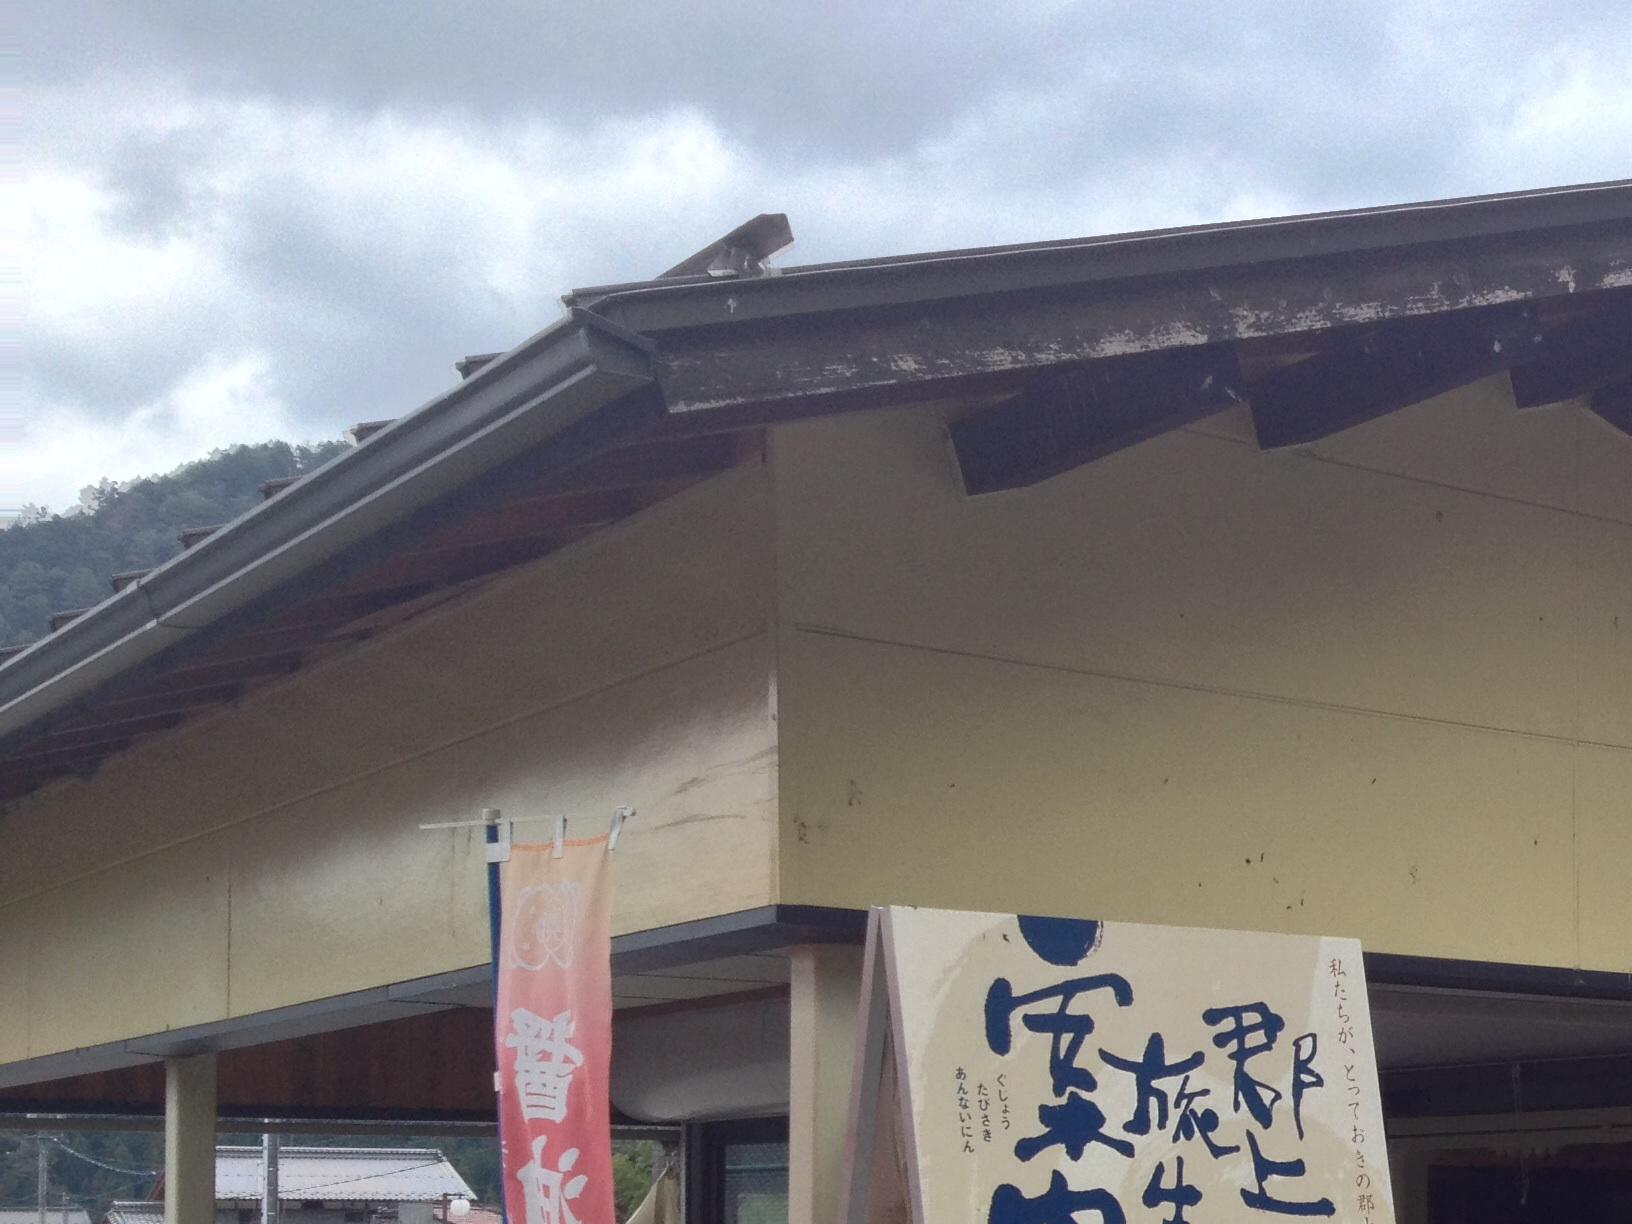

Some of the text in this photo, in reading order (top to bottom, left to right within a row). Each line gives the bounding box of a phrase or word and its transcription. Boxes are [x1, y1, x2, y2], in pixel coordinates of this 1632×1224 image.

[955, 1066, 975, 1153] あんないにん
[977, 1083, 993, 1143] たびさき
[1201, 1001, 1335, 1218] 郡上
